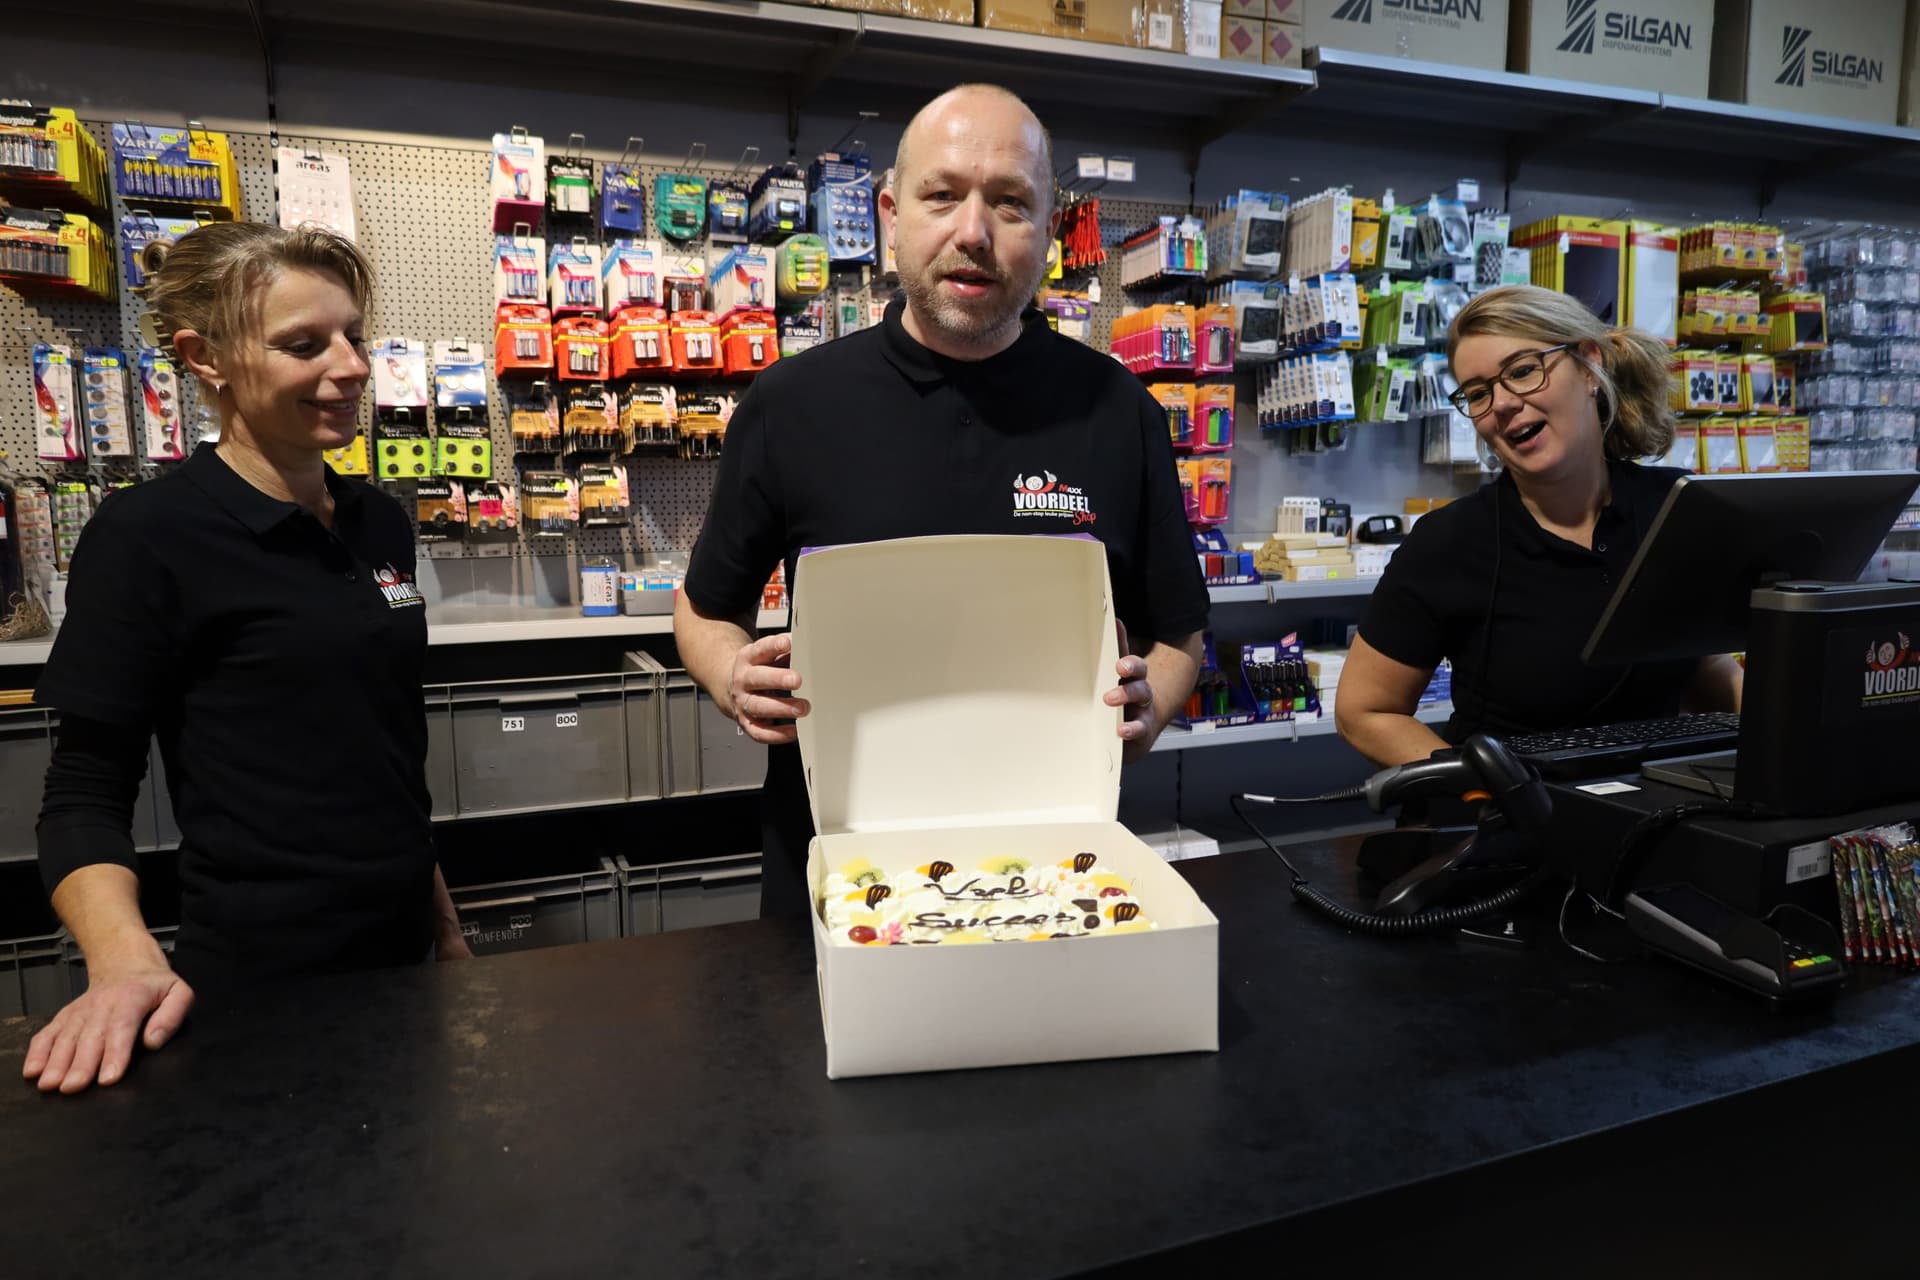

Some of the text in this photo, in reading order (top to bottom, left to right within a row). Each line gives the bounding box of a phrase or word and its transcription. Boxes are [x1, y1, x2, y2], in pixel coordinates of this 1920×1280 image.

[114, 136, 167, 151] VARTA
[780, 179, 805, 189] VARTA
[793, 327, 820, 337] VARTA
[1013, 491, 1090, 514] VOORDEEL
[503, 719, 524, 729] 751
[557, 714, 577, 725] 800
